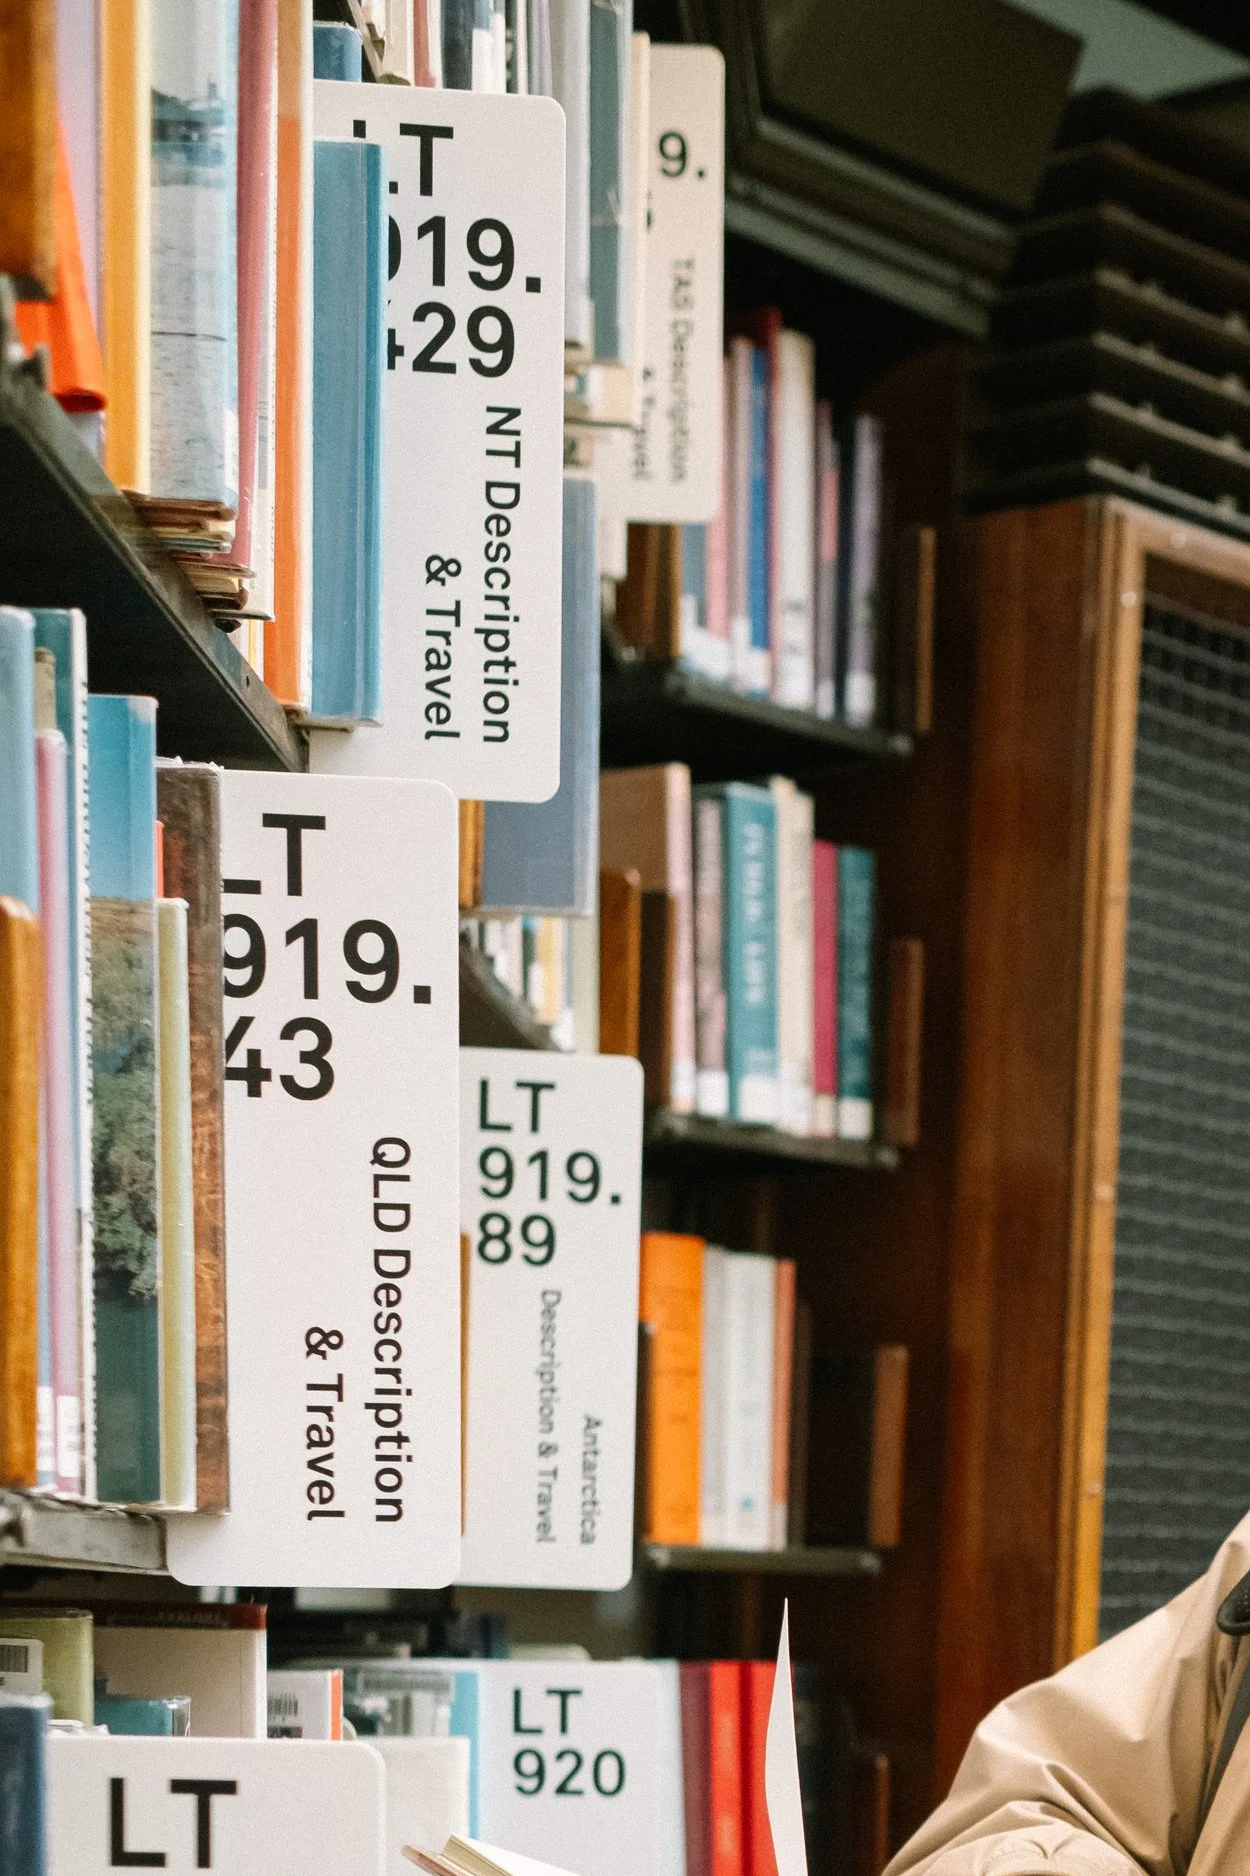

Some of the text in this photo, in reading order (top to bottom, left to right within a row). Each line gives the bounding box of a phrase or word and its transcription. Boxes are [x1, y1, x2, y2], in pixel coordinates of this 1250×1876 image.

[657, 130, 705, 180] 9.
[477, 405, 522, 744] NT Description
[424, 554, 463, 742] & Travel
[222, 913, 432, 1005] 919.
[223, 1015, 336, 1101] 43
[479, 1078, 557, 1134] LT
[478, 1146, 622, 1206] 919.
[477, 1211, 557, 1267] 89
[364, 1136, 413, 1524] QLD Description
[304, 1326, 346, 1522] & Travel
[535, 1288, 562, 1543] Description & Travel
[580, 1413, 603, 1546] Antarctica
[512, 1687, 583, 1736] LT
[513, 1747, 627, 1798] 920
[109, 1777, 238, 1869] LT
